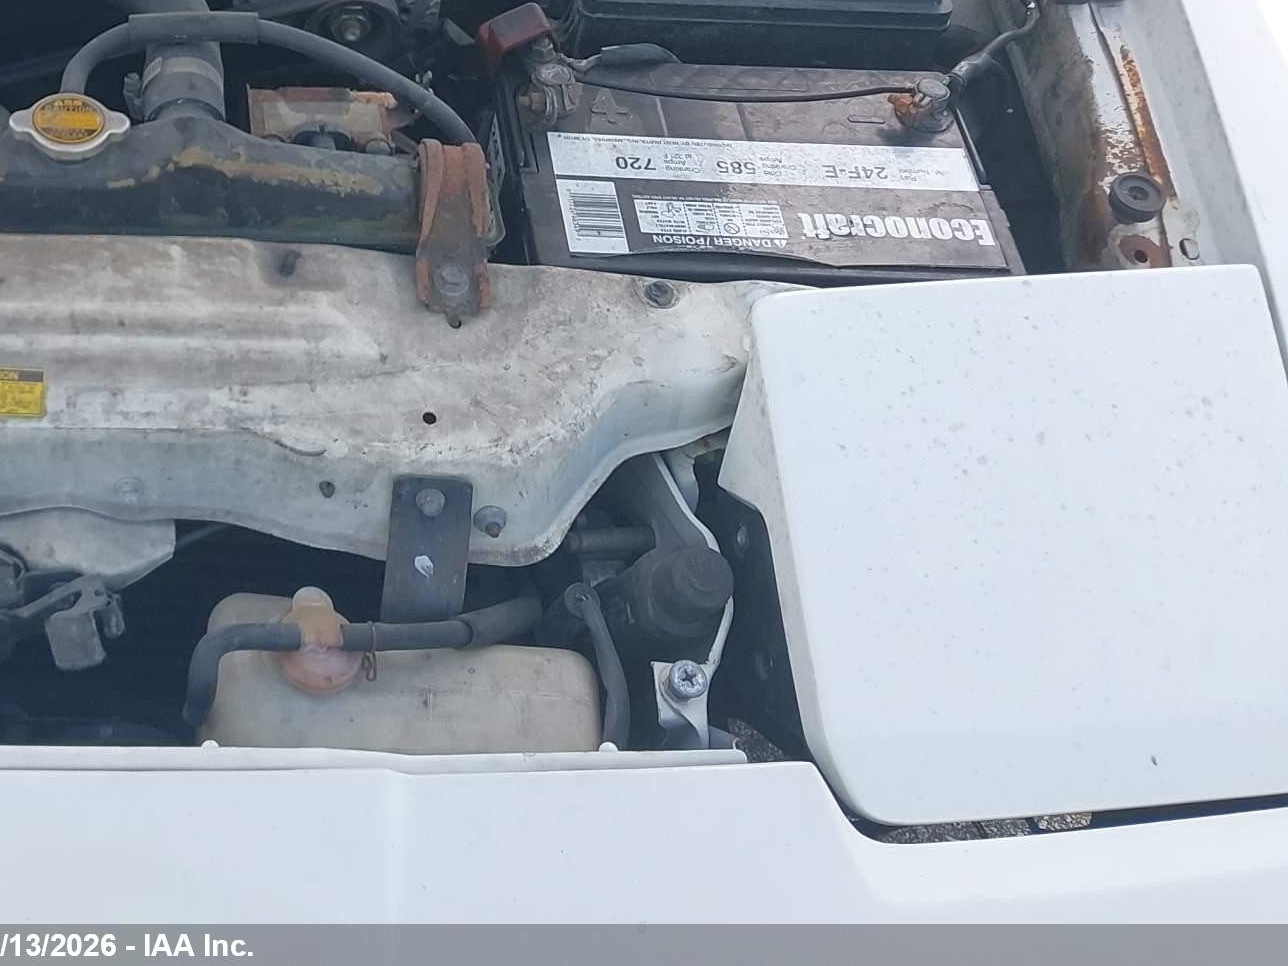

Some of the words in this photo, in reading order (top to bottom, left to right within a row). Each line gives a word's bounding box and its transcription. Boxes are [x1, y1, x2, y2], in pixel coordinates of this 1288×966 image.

[615, 156, 656, 170] 720
[717, 161, 756, 174] 585
[822, 164, 889, 180] 24F-E
[796, 212, 996, 246] Econocraft
[714, 236, 772, 248] DANGER
